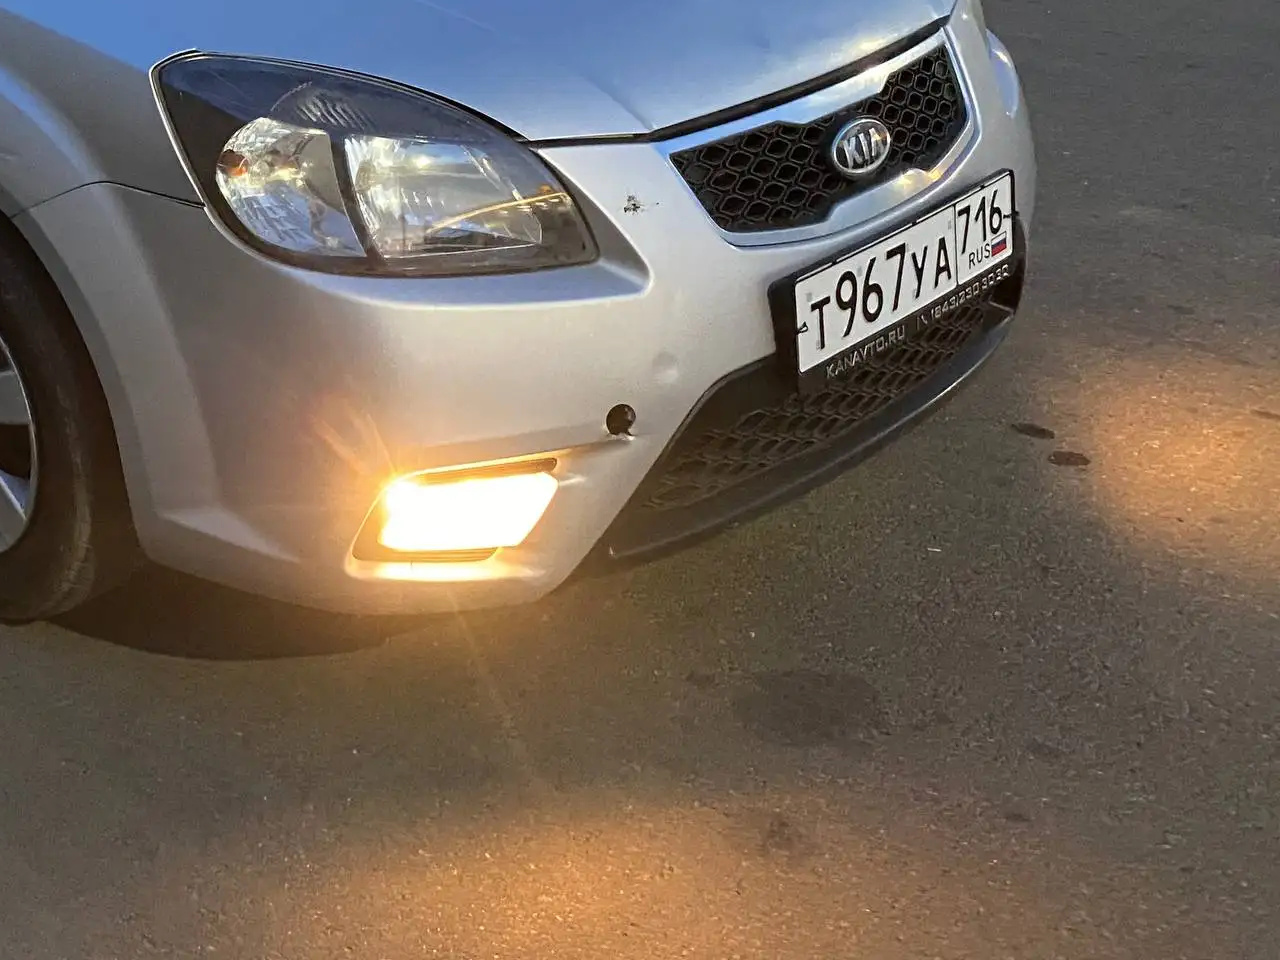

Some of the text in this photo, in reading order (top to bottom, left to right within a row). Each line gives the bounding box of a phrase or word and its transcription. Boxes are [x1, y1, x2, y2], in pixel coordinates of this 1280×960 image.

[842, 127, 885, 169] KIA
[957, 189, 1003, 255] 716
[968, 242, 991, 270] RUS
